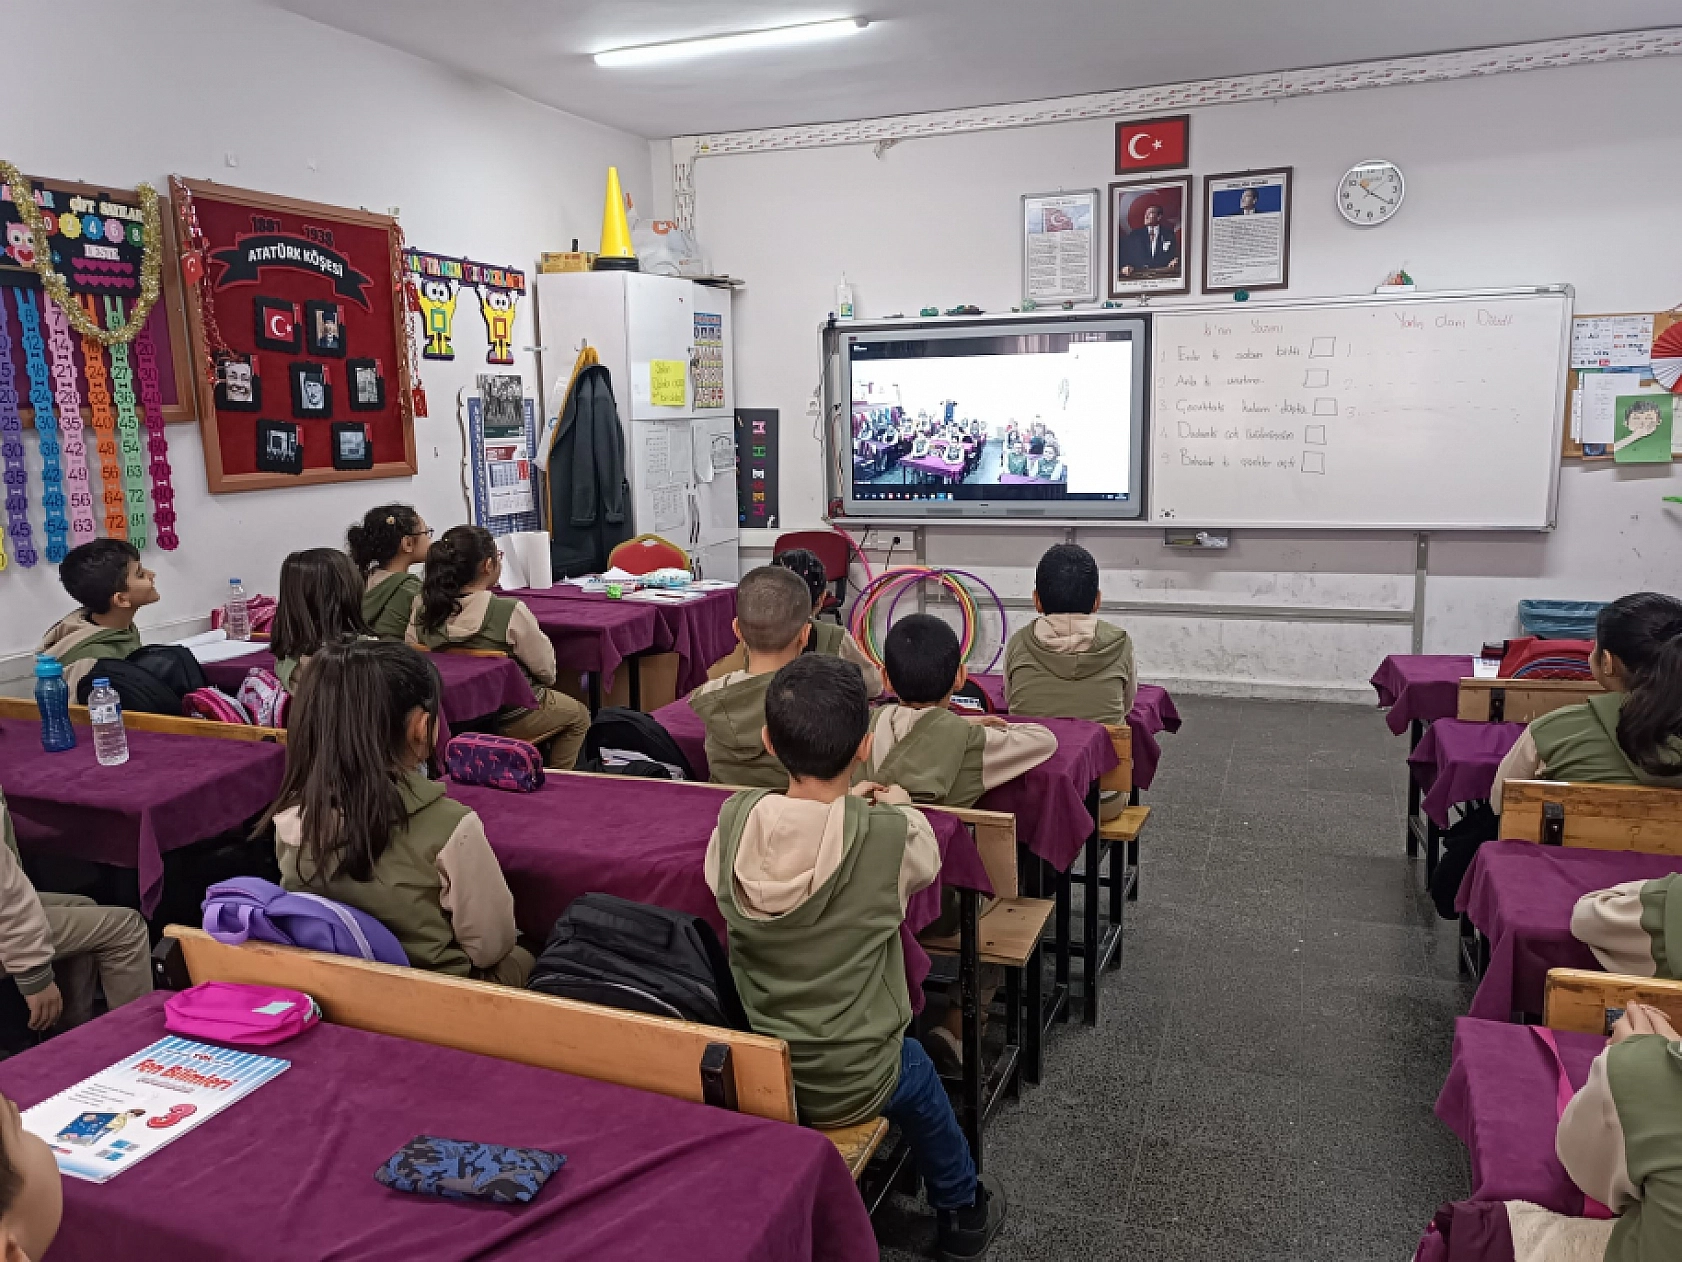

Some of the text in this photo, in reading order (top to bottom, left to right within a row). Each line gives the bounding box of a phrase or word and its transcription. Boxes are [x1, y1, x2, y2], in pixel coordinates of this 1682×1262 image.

[247, 242, 303, 262] ATATÜRK
[28, 336, 41, 350] 12
[54, 338, 70, 352] 14
[31, 364, 46, 378] 18
[57, 364, 74, 378] 21
[90, 366, 106, 379] 24
[114, 366, 129, 380] 27
[35, 391, 50, 405] 24
[1241, 398, 1271, 414] kalem
[1, 417, 20, 431] 25
[38, 416, 56, 431] 30
[62, 417, 83, 432] 35
[94, 417, 113, 430] 40
[119, 416, 137, 431] 45
[3, 443, 24, 458] 30
[41, 442, 60, 456] 36
[64, 442, 85, 457] 42
[98, 442, 116, 456] 48
[122, 440, 140, 454] 54
[3, 471, 26, 485] 35
[42, 468, 61, 482] 42
[67, 467, 88, 481] 49
[102, 466, 120, 480] 56
[126, 465, 143, 478] 63
[44, 494, 66, 509] 48
[71, 494, 92, 508] 56
[104, 491, 124, 505] 64
[128, 489, 145, 503] 72
[6, 498, 28, 512] 40
[46, 519, 69, 533] 54
[73, 519, 94, 533] 63
[106, 515, 125, 529] 72
[130, 513, 146, 527] 81
[10, 523, 32, 537] 45
[17, 550, 37, 566] 50
[146, 1103, 198, 1129] 3
